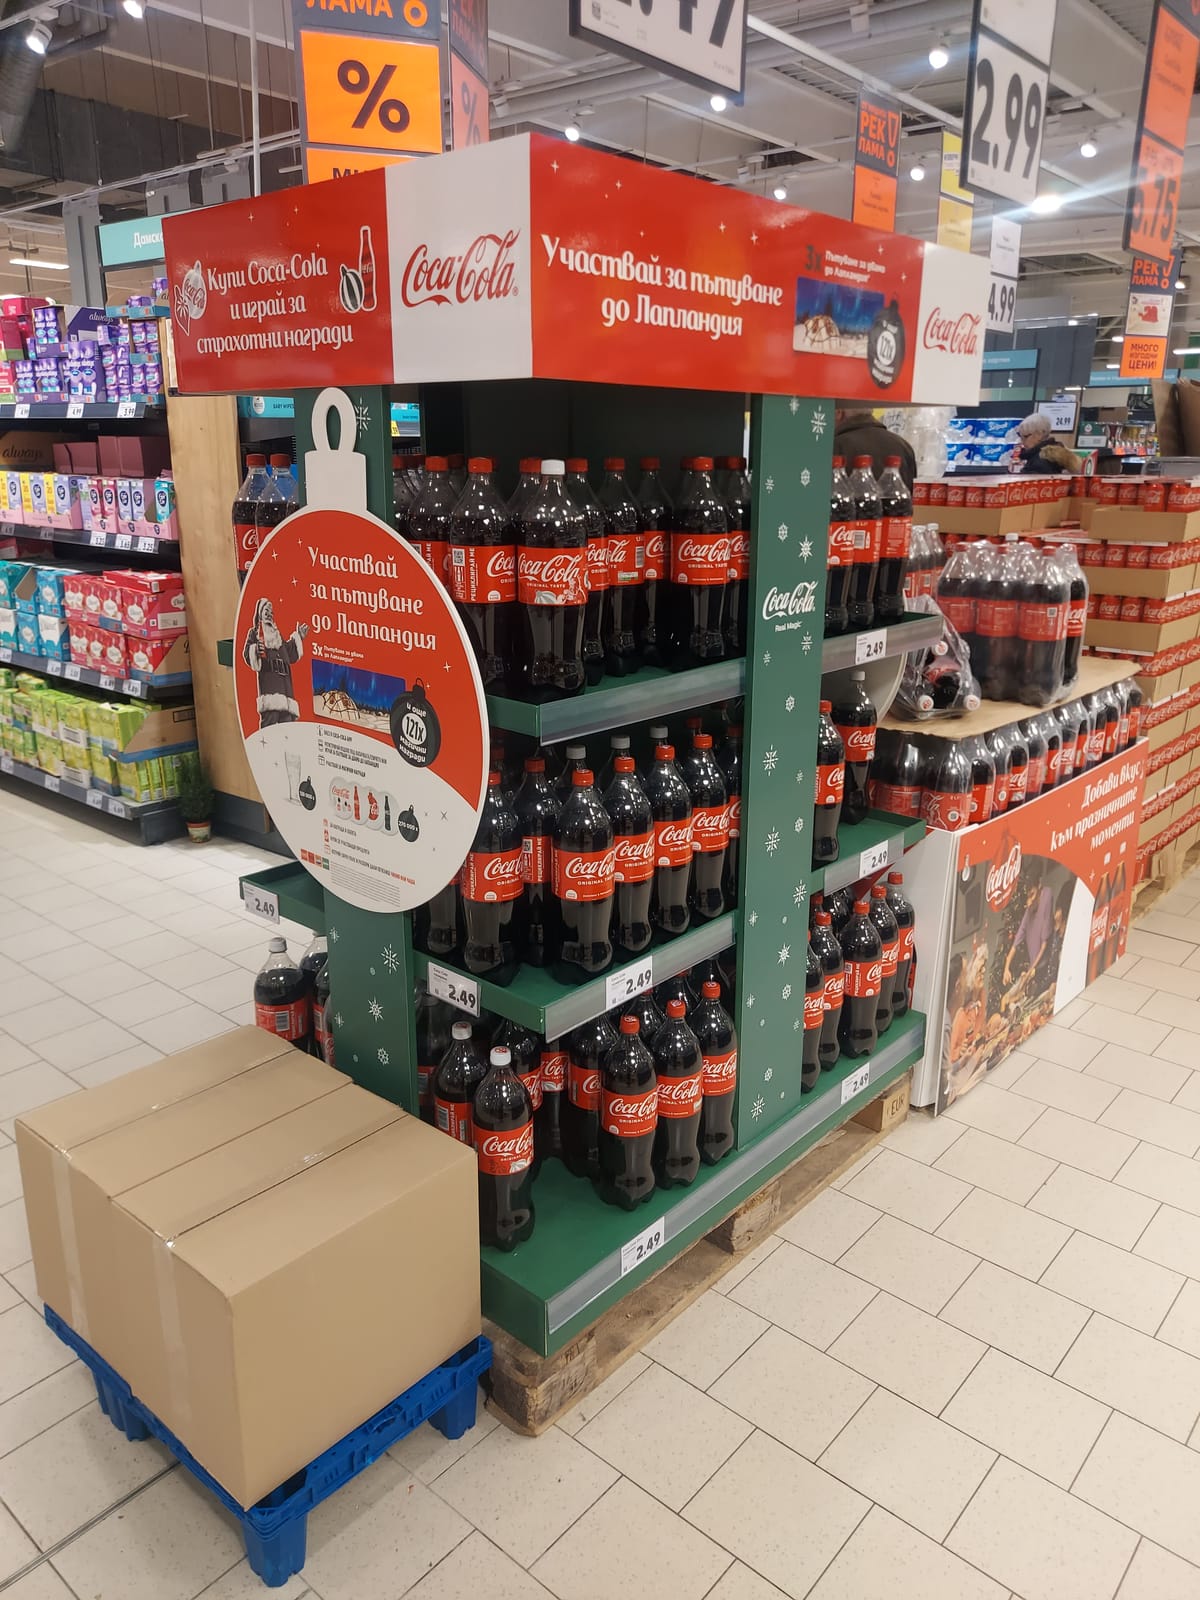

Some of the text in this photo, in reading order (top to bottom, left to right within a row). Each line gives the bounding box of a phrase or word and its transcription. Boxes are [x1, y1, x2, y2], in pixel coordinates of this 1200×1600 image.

[337, 60, 410, 133] %
[860, 111, 886, 143] РЕК
[971, 58, 1042, 179] 2.99
[858, 137, 885, 160] ЛАМА
[207, 266, 248, 296] Купи
[247, 252, 329, 286] Coca-Cola
[540, 234, 783, 307] Участвай за пътуване
[1132, 275, 1159, 287] ЛАМА
[1133, 258, 1159, 276] РЕК
[229, 290, 307, 324] и играй за
[601, 294, 743, 340] до Лапландия
[987, 282, 1016, 324] 4.99
[196, 323, 354, 358] страхотни награди
[1130, 343, 1159, 353] МНОГО
[1128, 360, 1157, 371] ЦЕНИ!
[1055, 416, 1071, 426] 24.99
[308, 545, 399, 579] Участвай
[309, 583, 424, 616] за пътуване
[311, 613, 437, 652] до Лапландия
[774, 624, 787, 633] Real
[866, 640, 883, 658] 2.49
[399, 743, 426, 763] награди
[1081, 760, 1141, 810] Добави вкус
[1050, 786, 1138, 852] към празничните
[1090, 811, 1135, 852] моменти
[871, 850, 888, 869] 2.49
[255, 897, 275, 917] 2.49
[447, 983, 476, 1009] 2.49
[626, 969, 652, 996] 2.49
[853, 1072, 869, 1094] 2.49
[636, 1231, 661, 1261] 2.49
